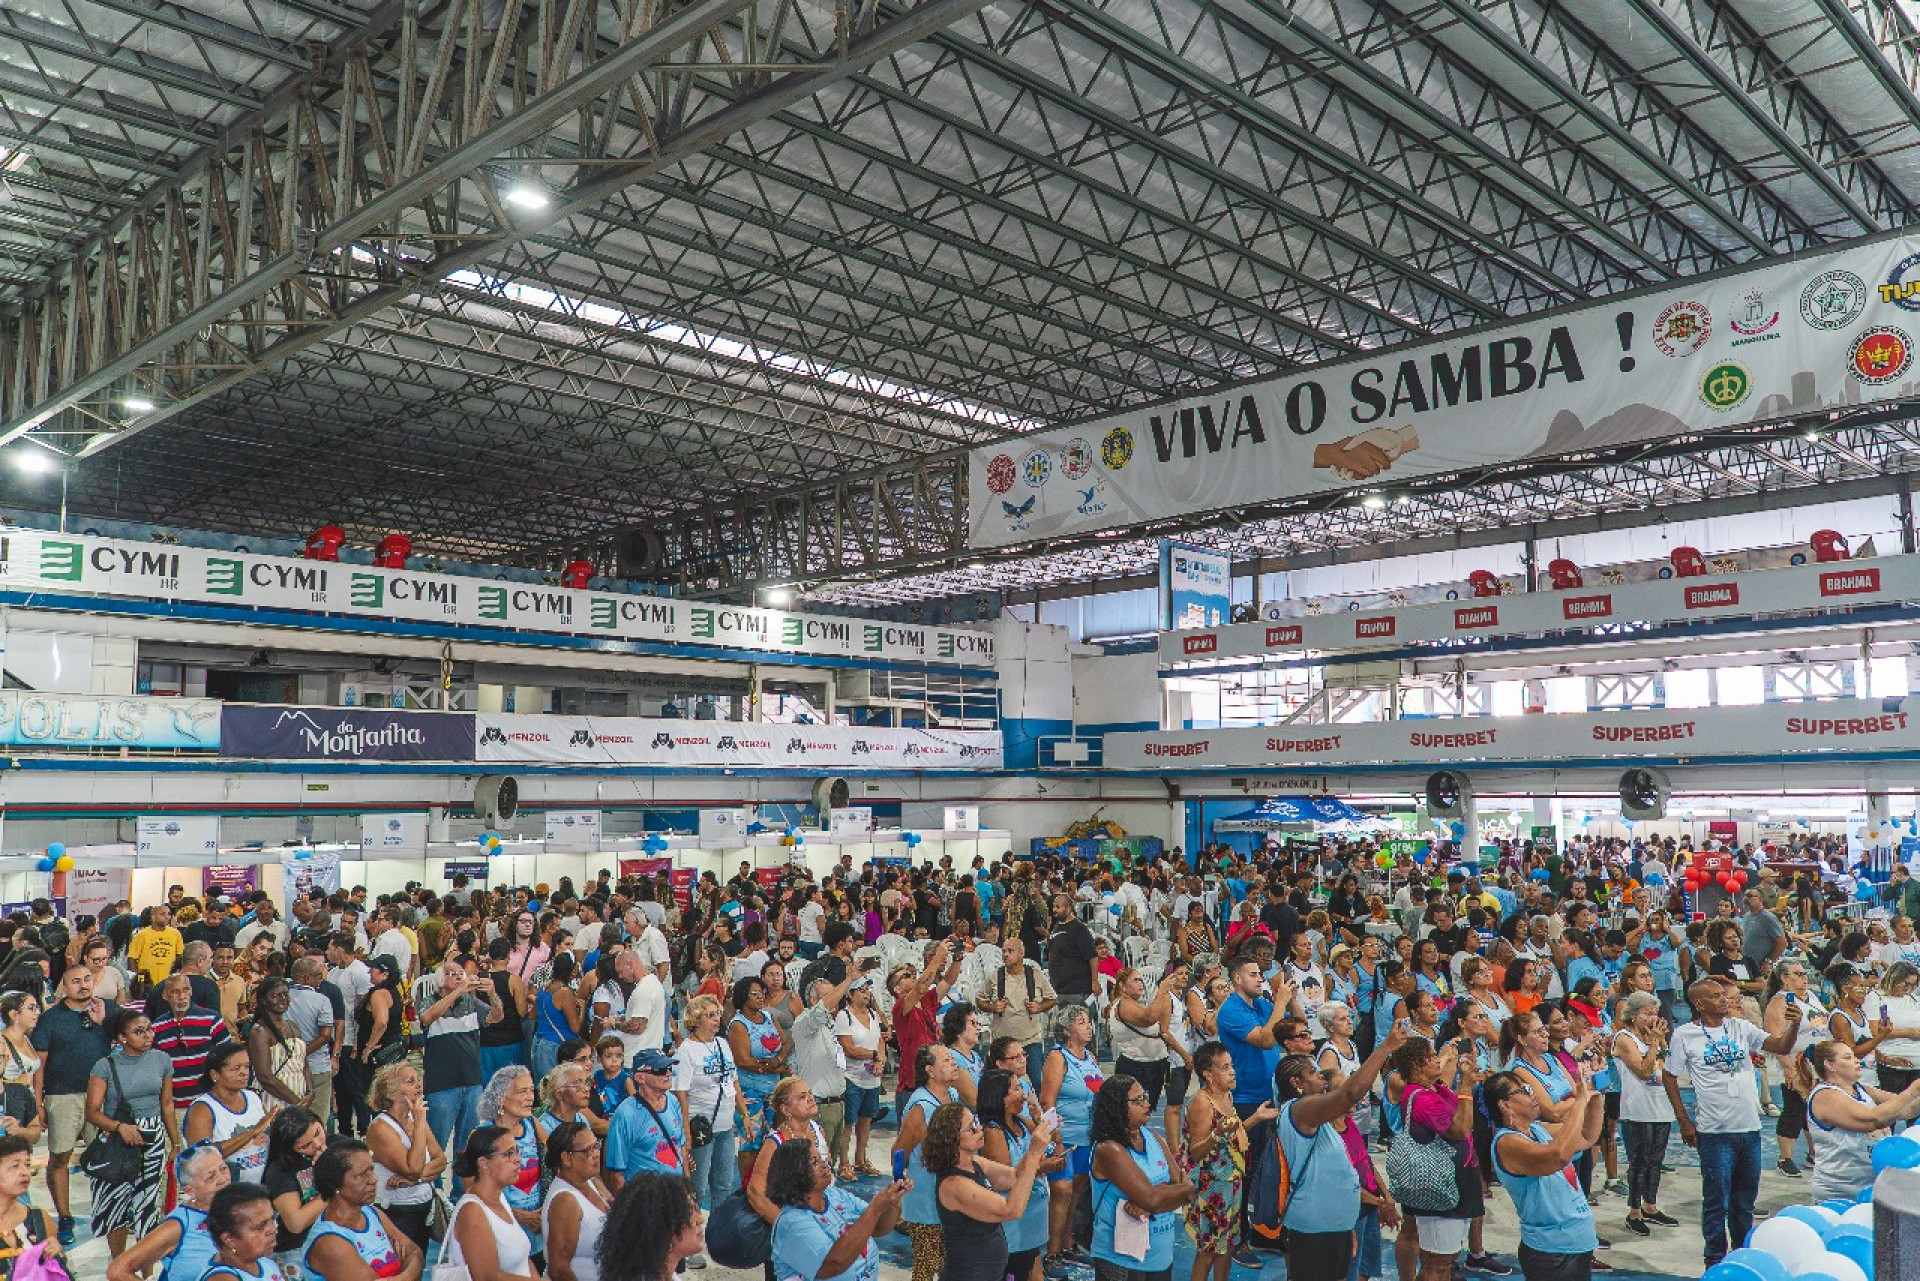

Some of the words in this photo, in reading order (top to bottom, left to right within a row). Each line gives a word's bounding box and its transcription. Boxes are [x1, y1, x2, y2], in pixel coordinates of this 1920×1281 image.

[1150, 395, 1266, 462] VIVA
[1285, 382, 1327, 435] O
[1350, 326, 1585, 423] SAMBA
[1616, 311, 1636, 373] !
[91, 547, 180, 577] CYMI
[250, 563, 327, 591] CYMI
[1827, 575, 1873, 591] BRAHMA
[389, 578, 457, 604] CYMI
[1691, 589, 1732, 604] BRAHMA
[512, 590, 572, 615] CYMI
[1568, 601, 1606, 614] BRAHMA
[621, 601, 674, 624] CYMI
[718, 612, 767, 633] CYMI
[806, 620, 850, 641] CYMI
[885, 628, 925, 647] CYMI
[957, 635, 994, 653] CYMI
[336, 721, 354, 734] da
[1592, 721, 1696, 742] SUPERBET
[1786, 712, 1908, 736] SUPERBET
[299, 722, 426, 755] Montanha
[508, 732, 551, 742] MENZOIL
[595, 734, 634, 744] MENZOIL
[675, 737, 711, 745] MENZOIL
[1266, 735, 1342, 752] SUPERBET
[1409, 729, 1497, 748] SUPERBET
[1144, 740, 1210, 757] SUPERBET
